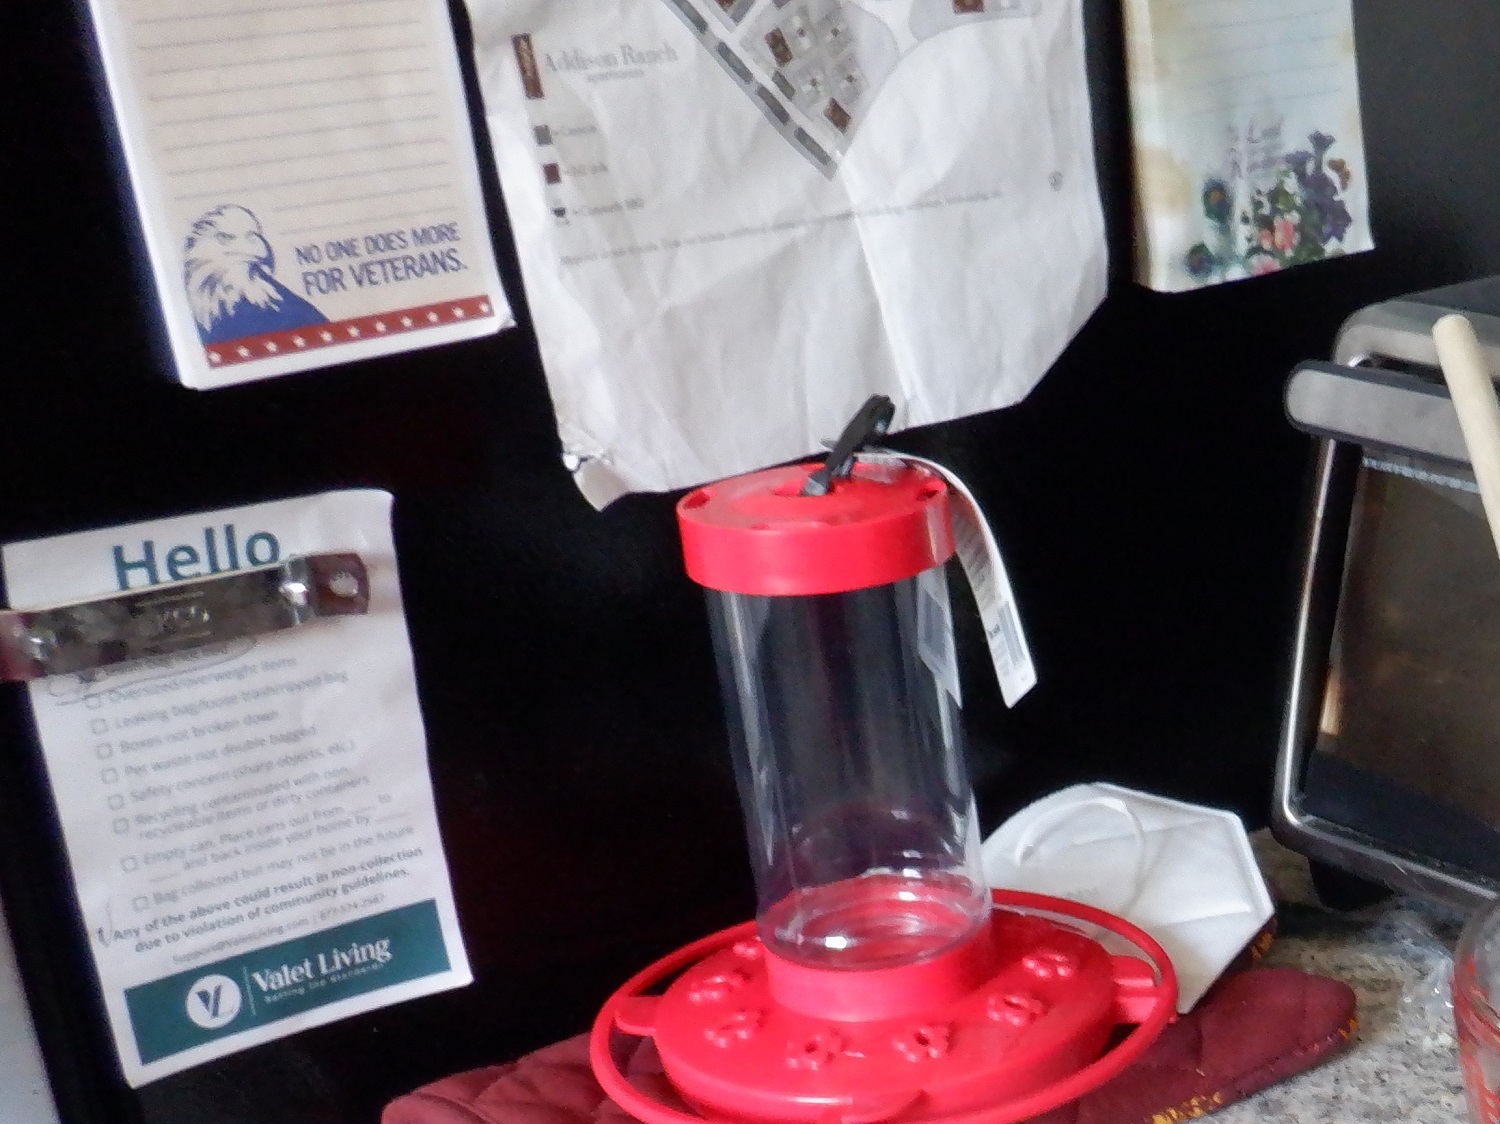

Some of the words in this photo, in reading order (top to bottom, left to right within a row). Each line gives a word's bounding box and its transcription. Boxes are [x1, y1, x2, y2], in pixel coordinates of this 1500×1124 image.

[295, 244, 323, 265] NO
[326, 238, 360, 260] ONE
[364, 231, 408, 255] DOES
[411, 222, 459, 246] MORE
[301, 267, 345, 296] FOR
[350, 248, 467, 288] VETERANS.
[112, 524, 281, 591] Hello
[120, 738, 162, 754] Boxes
[166, 730, 190, 742] not
[192, 720, 240, 738] broken
[244, 711, 278, 725] down
[152, 756, 192, 772] waste
[196, 748, 218, 760] not
[222, 738, 266, 756] double
[130, 786, 172, 802] Safety
[176, 771, 230, 790] concern
[134, 804, 198, 824] Recycling
[203, 780, 290, 808] contaminated
[216, 806, 252, 820] items
[306, 776, 368, 798] containers
[144, 848, 186, 866] Empty
[220, 830, 254, 844] Place
[290, 814, 310, 826] out
[312, 806, 342, 820] from
[184, 856, 208, 870] and
[210, 848, 241, 862] back
[316, 819, 350, 834] home
[320, 846, 336, 858] be
[340, 842, 352, 852] in
[352, 836, 374, 848] the
[376, 826, 414, 841] future
[114, 928, 140, 940] Any
[144, 918, 159, 932] of
[162, 914, 185, 926] the
[190, 902, 230, 920] above
[234, 887, 270, 906] could
[274, 876, 313, 894] result
[316, 874, 328, 884] in
[331, 850, 422, 878] non-collection
[136, 938, 161, 952] due
[164, 932, 180, 944] to
[184, 914, 244, 937] violation
[248, 906, 260, 920] of
[264, 888, 338, 914] community
[340, 870, 407, 896] guidelines.
[253, 960, 312, 990] Valet
[318, 940, 392, 974] Living
